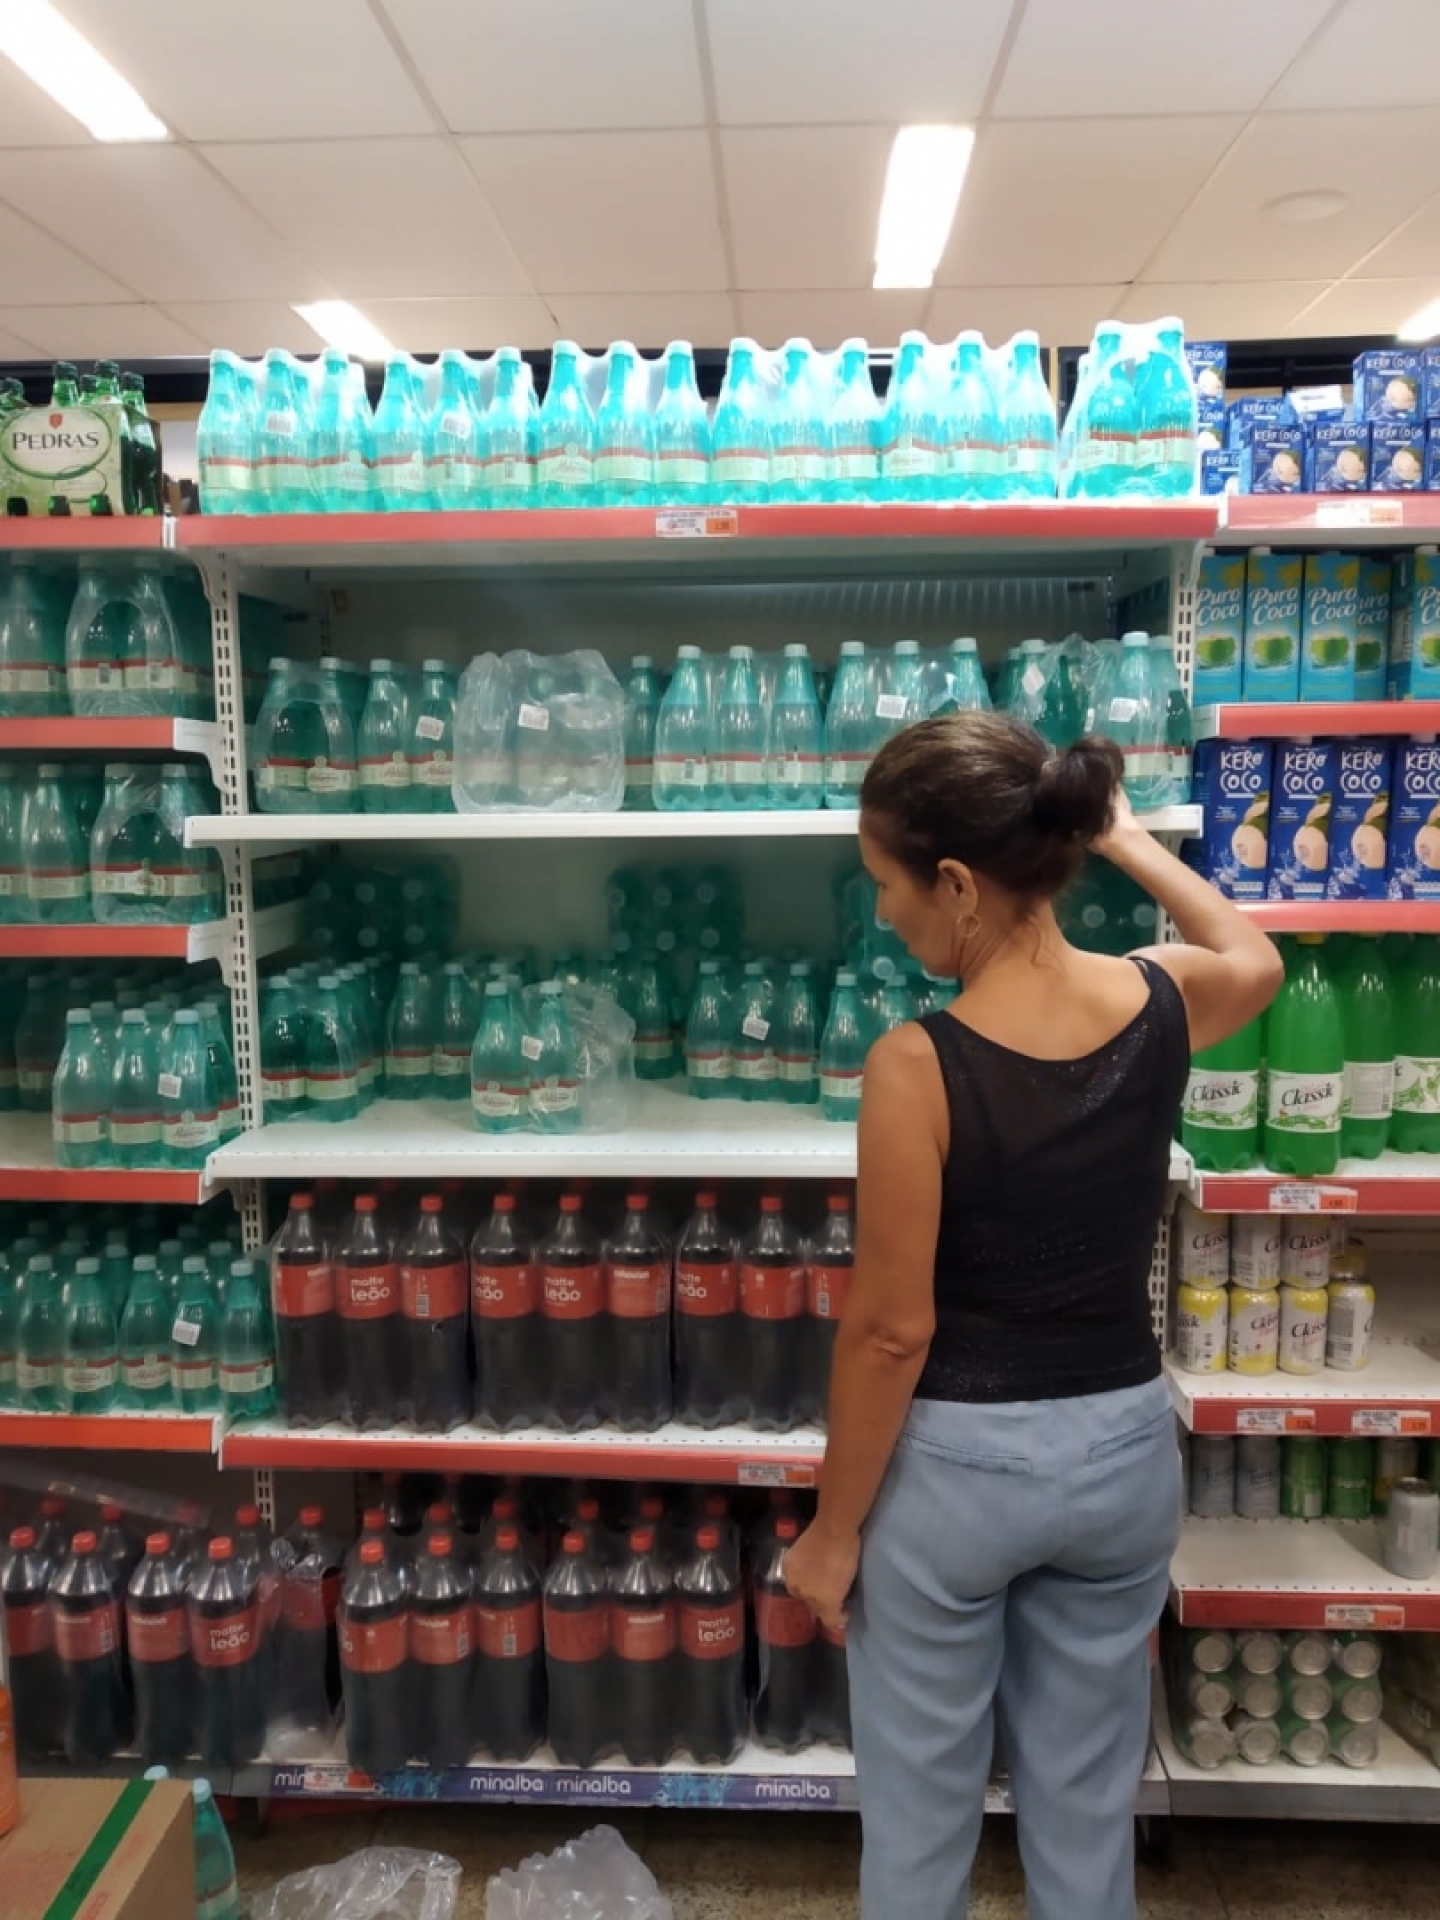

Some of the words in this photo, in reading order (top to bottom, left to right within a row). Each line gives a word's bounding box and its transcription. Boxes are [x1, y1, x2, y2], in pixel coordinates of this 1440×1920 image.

[12, 432, 98, 450] PEDRAS
[1198, 588, 1240, 608] Puro
[1248, 588, 1298, 609] Puro
[1308, 588, 1357, 608] Puro
[1360, 594, 1389, 610] uro
[1197, 604, 1240, 626] Coco
[1253, 603, 1297, 625] Coco
[1311, 603, 1356, 625] Coco
[1358, 609, 1389, 624] oco
[1220, 750, 1264, 770] KERO
[1284, 751, 1327, 771] KERO
[1341, 750, 1383, 770] KERO
[1406, 750, 1440, 770] KER
[1220, 770, 1262, 793] COCO
[1283, 771, 1324, 794] COCO
[1340, 770, 1382, 793] COCO
[1191, 1080, 1243, 1104] Classic
[1281, 1083, 1335, 1106] Classic
[351, 1276, 385, 1286] matte
[351, 1286, 390, 1302] leão
[545, 1284, 581, 1301] leão
[211, 1631, 250, 1651] leão
[698, 1626, 735, 1642] leão
[470, 1774, 544, 1792] minalba
[556, 1776, 632, 1794] minalba
[755, 1779, 832, 1799] minalba
